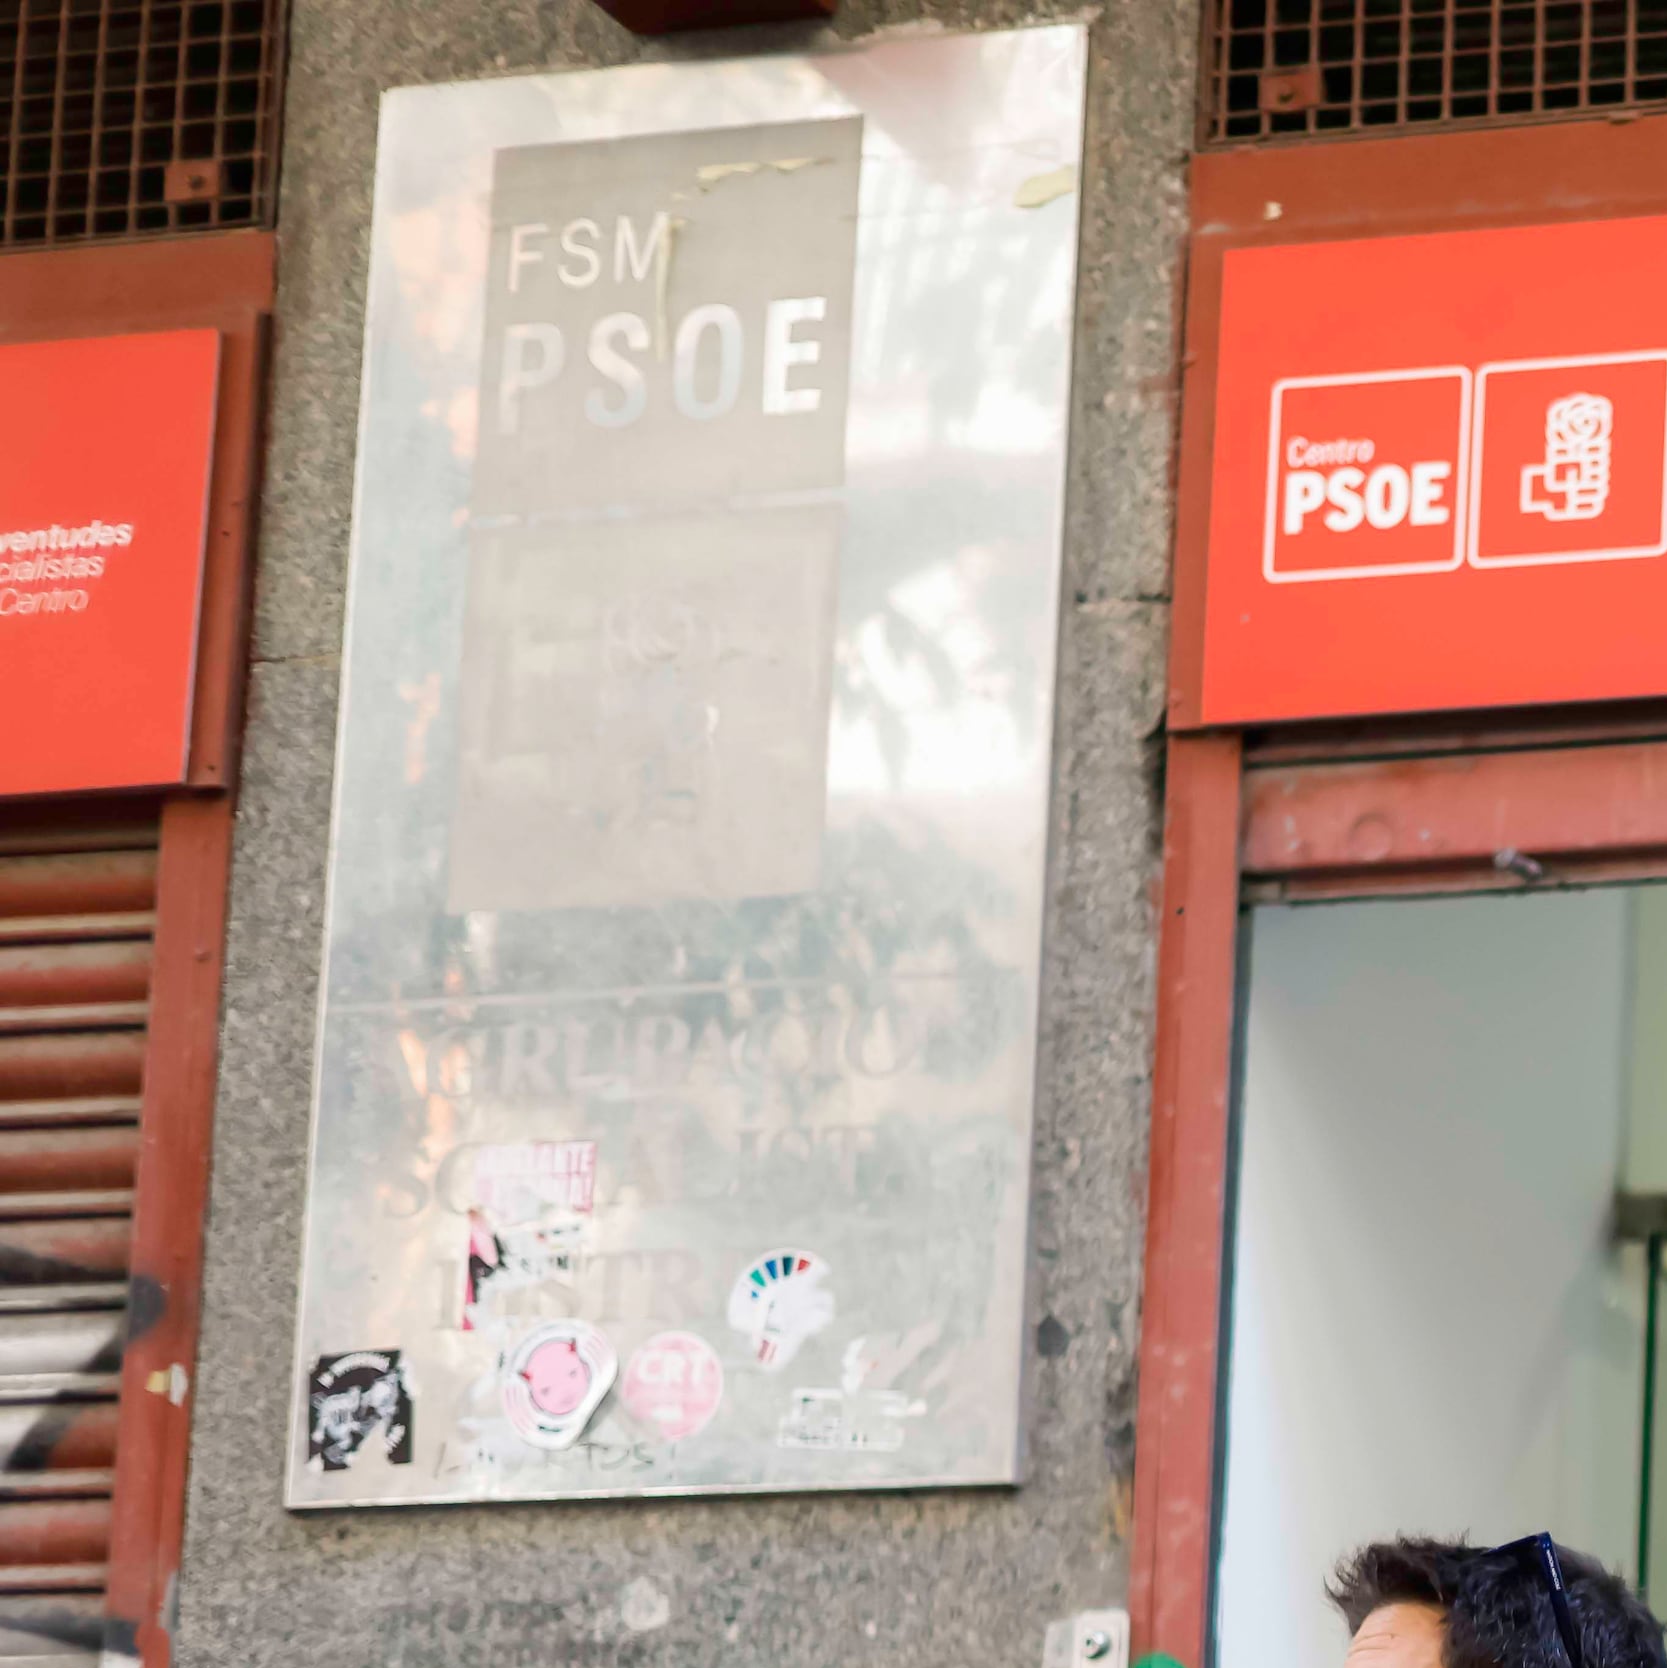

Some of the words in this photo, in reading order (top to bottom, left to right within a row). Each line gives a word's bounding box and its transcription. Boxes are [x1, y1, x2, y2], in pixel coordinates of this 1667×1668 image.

[507, 211, 669, 293] FSM
[496, 296, 827, 434] PSOE
[1286, 436, 1375, 468] Centro
[1283, 460, 1451, 536] PSOE
[0, 587, 89, 615] Centro
